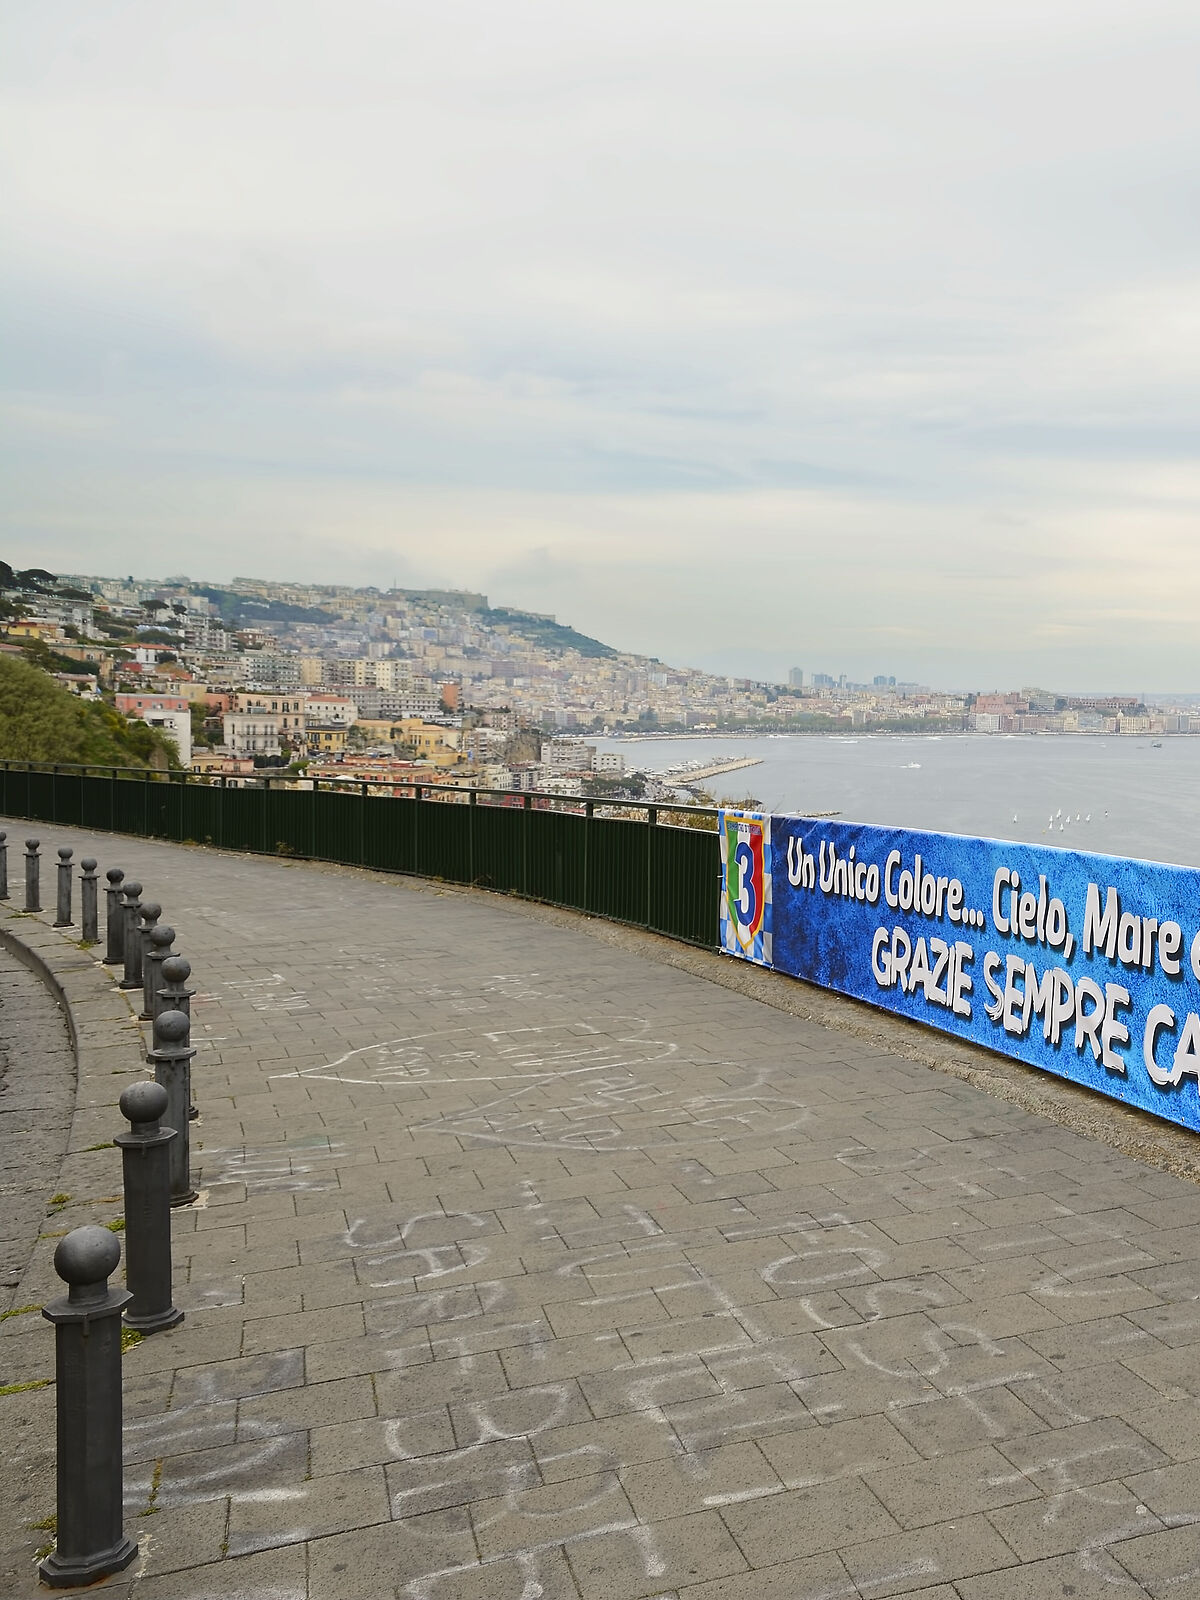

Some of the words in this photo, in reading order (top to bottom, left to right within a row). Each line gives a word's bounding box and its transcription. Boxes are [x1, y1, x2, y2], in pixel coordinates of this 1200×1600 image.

[734, 842, 756, 926] 3
[787, 836, 815, 888] Un
[819, 841, 880, 902] Unico
[885, 850, 985, 928] Colore...
[993, 867, 1076, 958] Cielo,
[1083, 883, 1182, 975] Mare
[872, 926, 973, 1017] GRAZIE
[984, 952, 1130, 1073] SEMPRE
